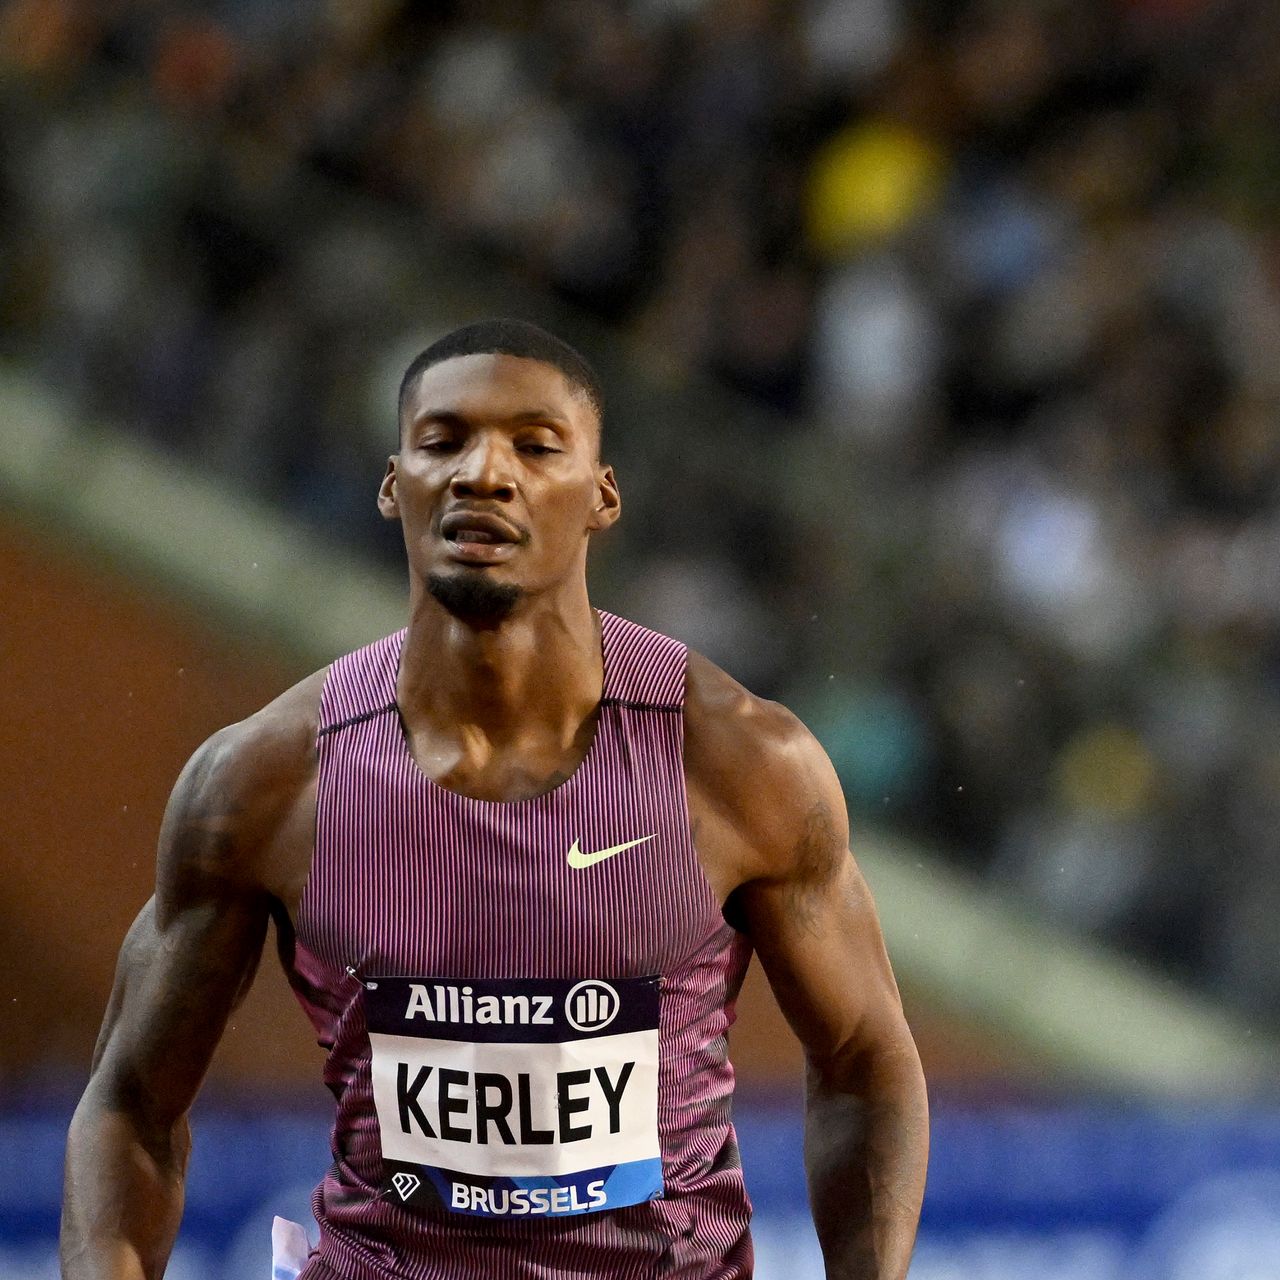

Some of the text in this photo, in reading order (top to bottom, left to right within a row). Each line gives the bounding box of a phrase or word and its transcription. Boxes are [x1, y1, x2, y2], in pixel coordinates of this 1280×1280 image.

[405, 983, 554, 1025] Allianz
[396, 1061, 636, 1145] KERLEY
[450, 1179, 607, 1216] BRUSSELS
